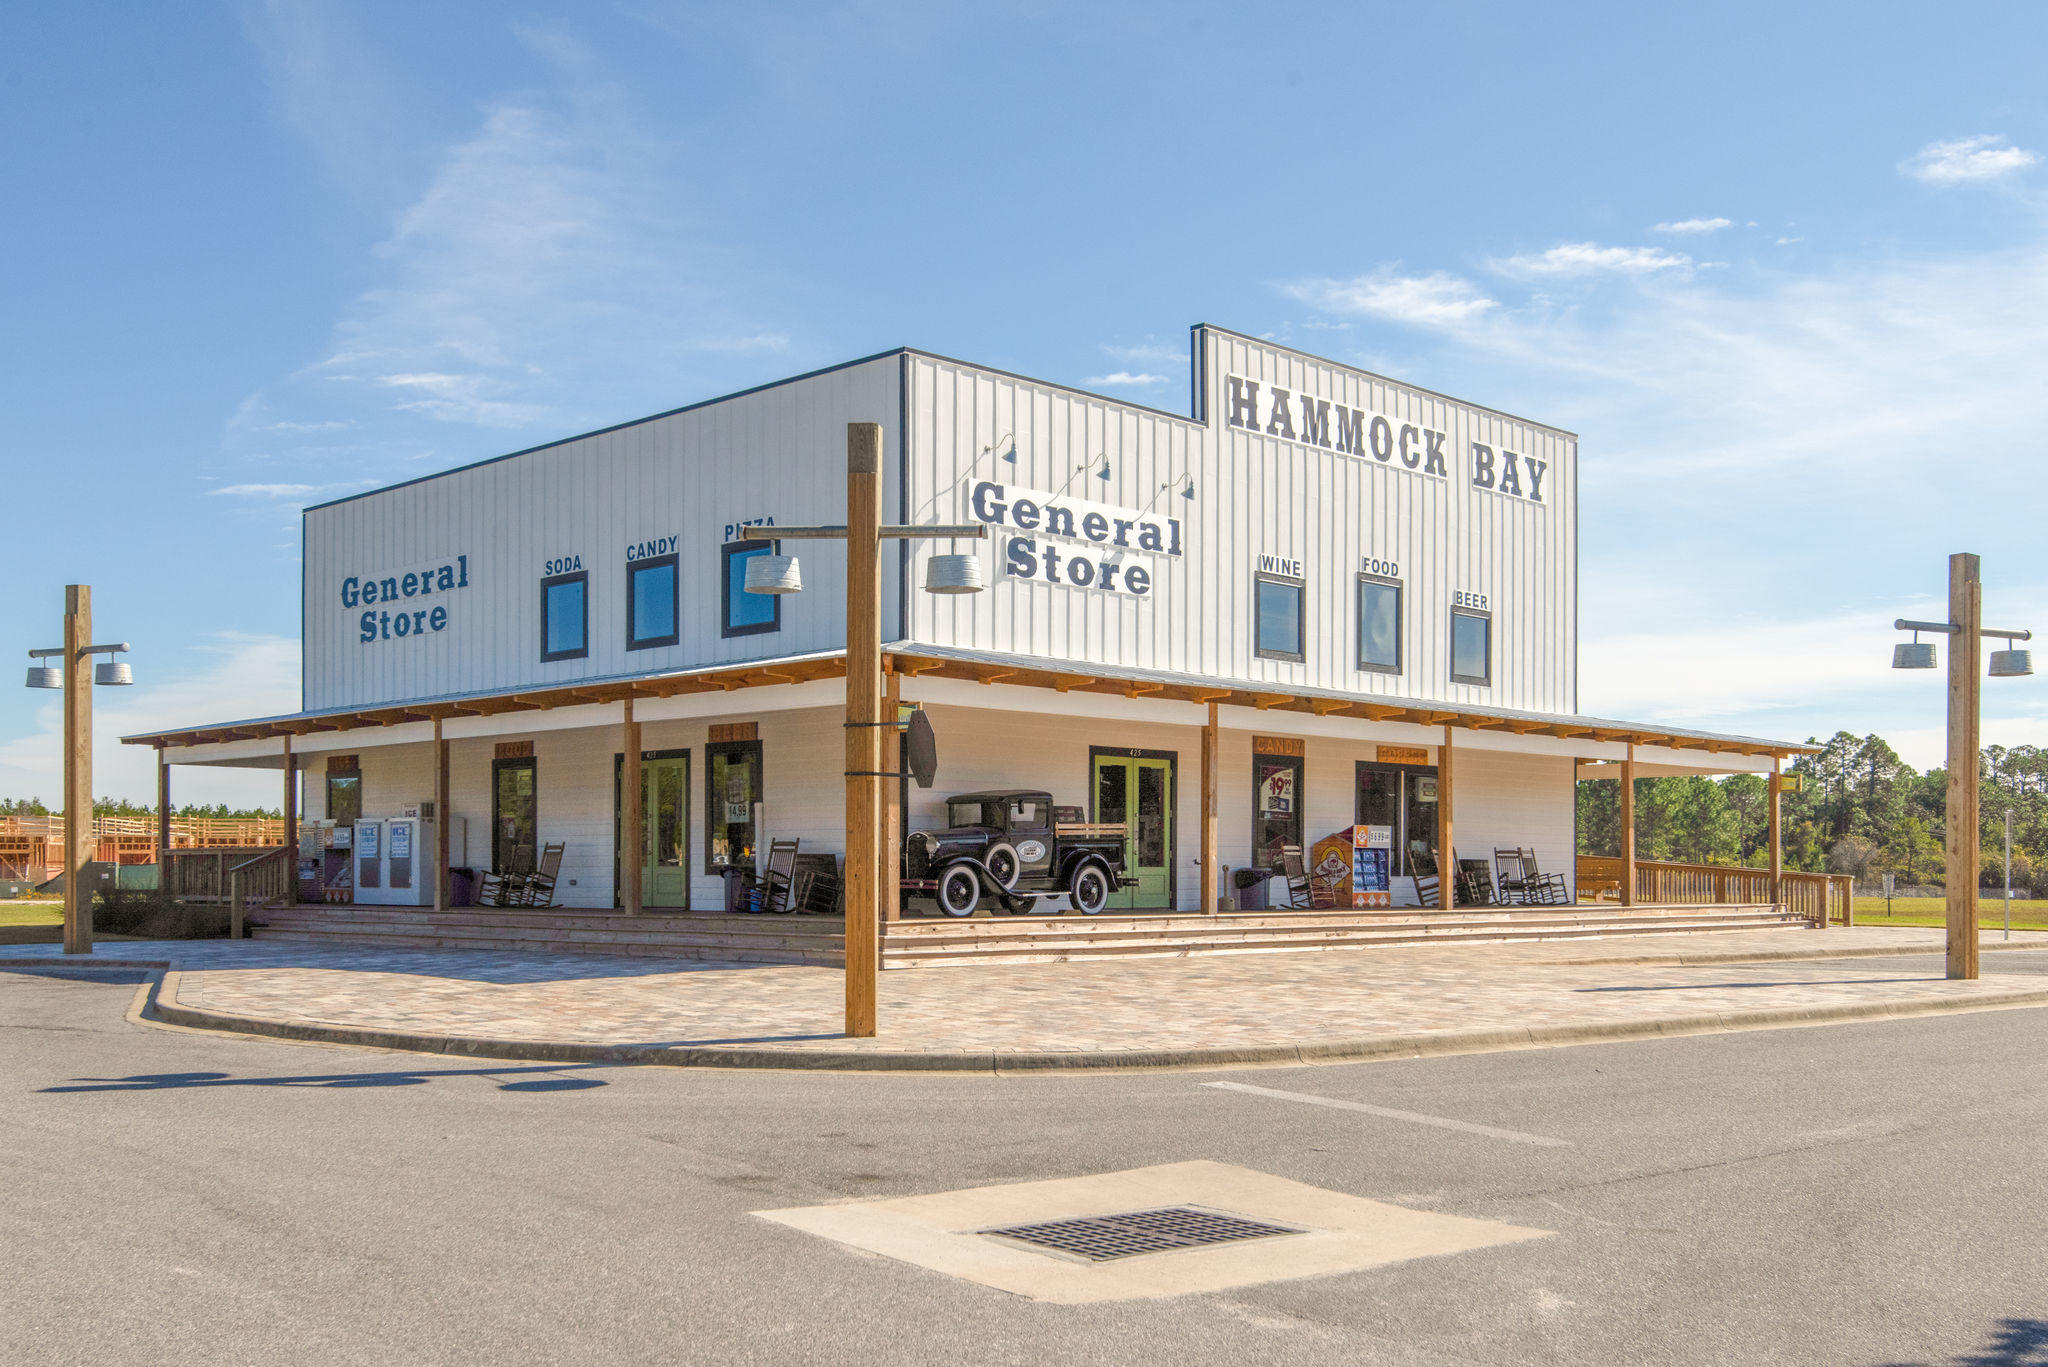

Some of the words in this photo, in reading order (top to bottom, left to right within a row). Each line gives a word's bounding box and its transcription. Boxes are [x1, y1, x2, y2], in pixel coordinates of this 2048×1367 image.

[1229, 375, 1447, 478] HAMMOCK
[1472, 441, 1547, 502] BAY
[724, 516, 775, 542] PIA
[971, 481, 1182, 556] General
[626, 535, 679, 561] CANDY
[545, 554, 582, 576] SODA
[1007, 536, 1151, 595] Store
[1262, 554, 1301, 577] WINE
[1363, 557, 1399, 577] FOOD
[341, 555, 469, 609] General
[1456, 590, 1488, 610] BEER
[360, 605, 448, 643] Store
[1256, 737, 1303, 755] CANDY
[392, 826, 408, 837] ICE
